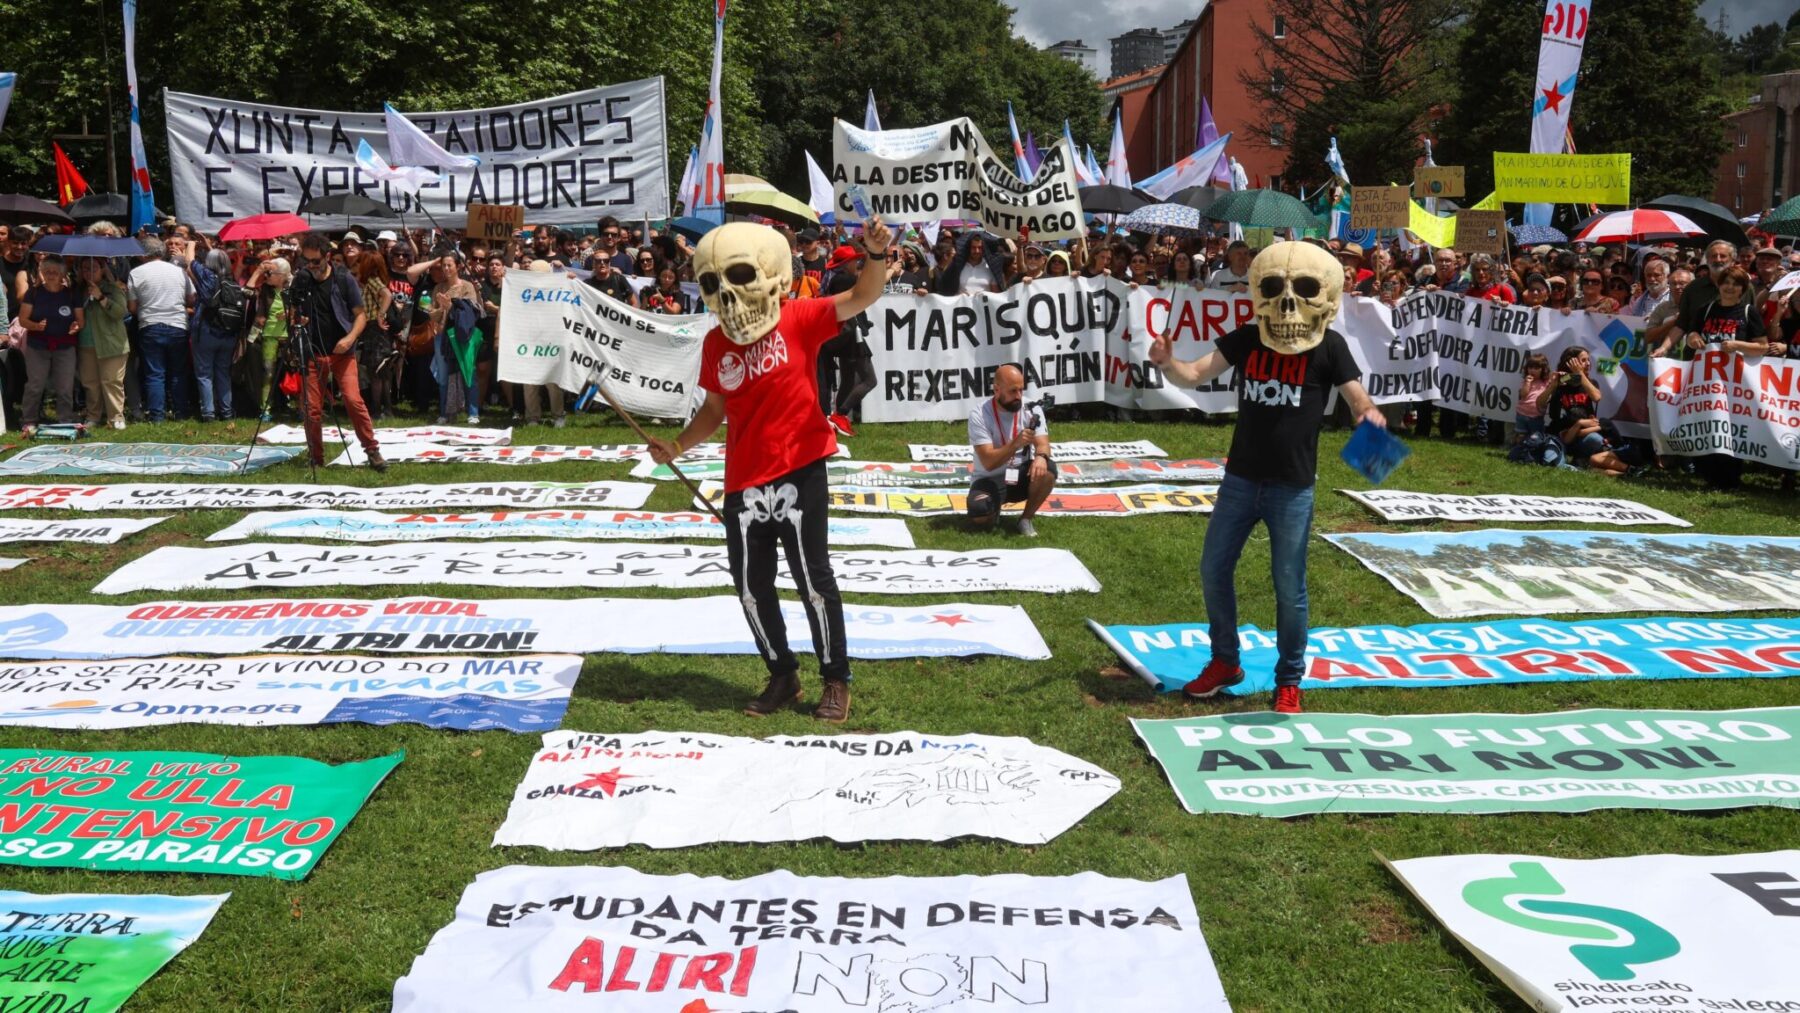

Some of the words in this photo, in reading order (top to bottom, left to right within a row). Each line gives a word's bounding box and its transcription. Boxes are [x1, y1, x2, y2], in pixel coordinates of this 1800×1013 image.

[201, 107, 354, 155] XUNTA
[381, 96, 633, 154] AIDORES
[205, 167, 234, 218] E
[833, 163, 848, 184] A
[854, 164, 885, 186] LA
[1036, 181, 1075, 206] DEL
[1354, 189, 1380, 201] ESTA
[478, 206, 517, 222] ALTRI
[839, 192, 939, 214] CMINO
[967, 192, 1076, 233] SNTIAGO
[1363, 200, 1408, 213] INDUSTRIA
[484, 222, 513, 238] NON
[521, 288, 582, 306] GALIZA
[596, 304, 632, 327] NON
[635, 319, 657, 334] SE
[1392, 290, 1466, 330] DEFENDER
[1467, 303, 1482, 329] A
[1487, 305, 1539, 337] TERRA
[562, 316, 624, 351] VENDE
[516, 344, 529, 356] O
[1474, 343, 1489, 369] A
[570, 350, 605, 374] NON
[610, 366, 632, 384] SE
[639, 375, 685, 395] TOCA
[749, 349, 788, 380] NON
[885, 337, 1102, 403] REXENEACIÓN
[1245, 349, 1308, 385] ALTRI
[1653, 351, 1744, 395] ATRI
[1243, 379, 1302, 408] NON
[1441, 373, 1471, 405] QUE
[1475, 381, 1512, 412] NOS
[1682, 382, 1729, 401] EFENSA
[1732, 386, 1756, 401] DO
[1732, 403, 1753, 418] DA
[1731, 424, 1749, 439] DE
[612, 512, 724, 523] NO
[126, 602, 369, 621] QUEREMOS
[103, 618, 358, 638] QUEREMOS
[261, 631, 411, 650] ALTRI
[415, 630, 539, 650] NON!
[1127, 629, 1211, 653] NA
[1520, 623, 1631, 647] DA
[1625, 621, 1800, 643] NOSA
[237, 660, 385, 675] VIVINDO
[397, 661, 450, 674] DO
[462, 659, 544, 676] MAR
[1307, 647, 1636, 681] ALTRI
[257, 676, 543, 694] saneadas
[110, 701, 302, 717] Opmega
[1173, 722, 1414, 748] POLO
[1432, 719, 1793, 747] FUTURO
[873, 739, 914, 757] DA
[1196, 746, 1458, 774] ALTRI
[1472, 745, 1737, 772] NON!
[2, 756, 131, 776] RURAL
[148, 762, 241, 778] VIVO
[3, 776, 116, 798] NO
[127, 778, 295, 811] ULLA
[526, 783, 604, 800] GALIZA
[79, 837, 313, 871] PARAÍSO
[1, 910, 141, 937] TERRA,
[486, 895, 819, 928] ESTUDANTES
[837, 901, 906, 930] EN
[927, 900, 1183, 931] DEFENSA
[630, 919, 708, 947] DA
[729, 924, 908, 947] TERRA
[548, 935, 759, 998] ALTRI
[792, 950, 1050, 1007] NON
[1553, 978, 1693, 993] sindicato
[1566, 994, 1690, 1008] labrego
[1698, 998, 1800, 1013] galego
